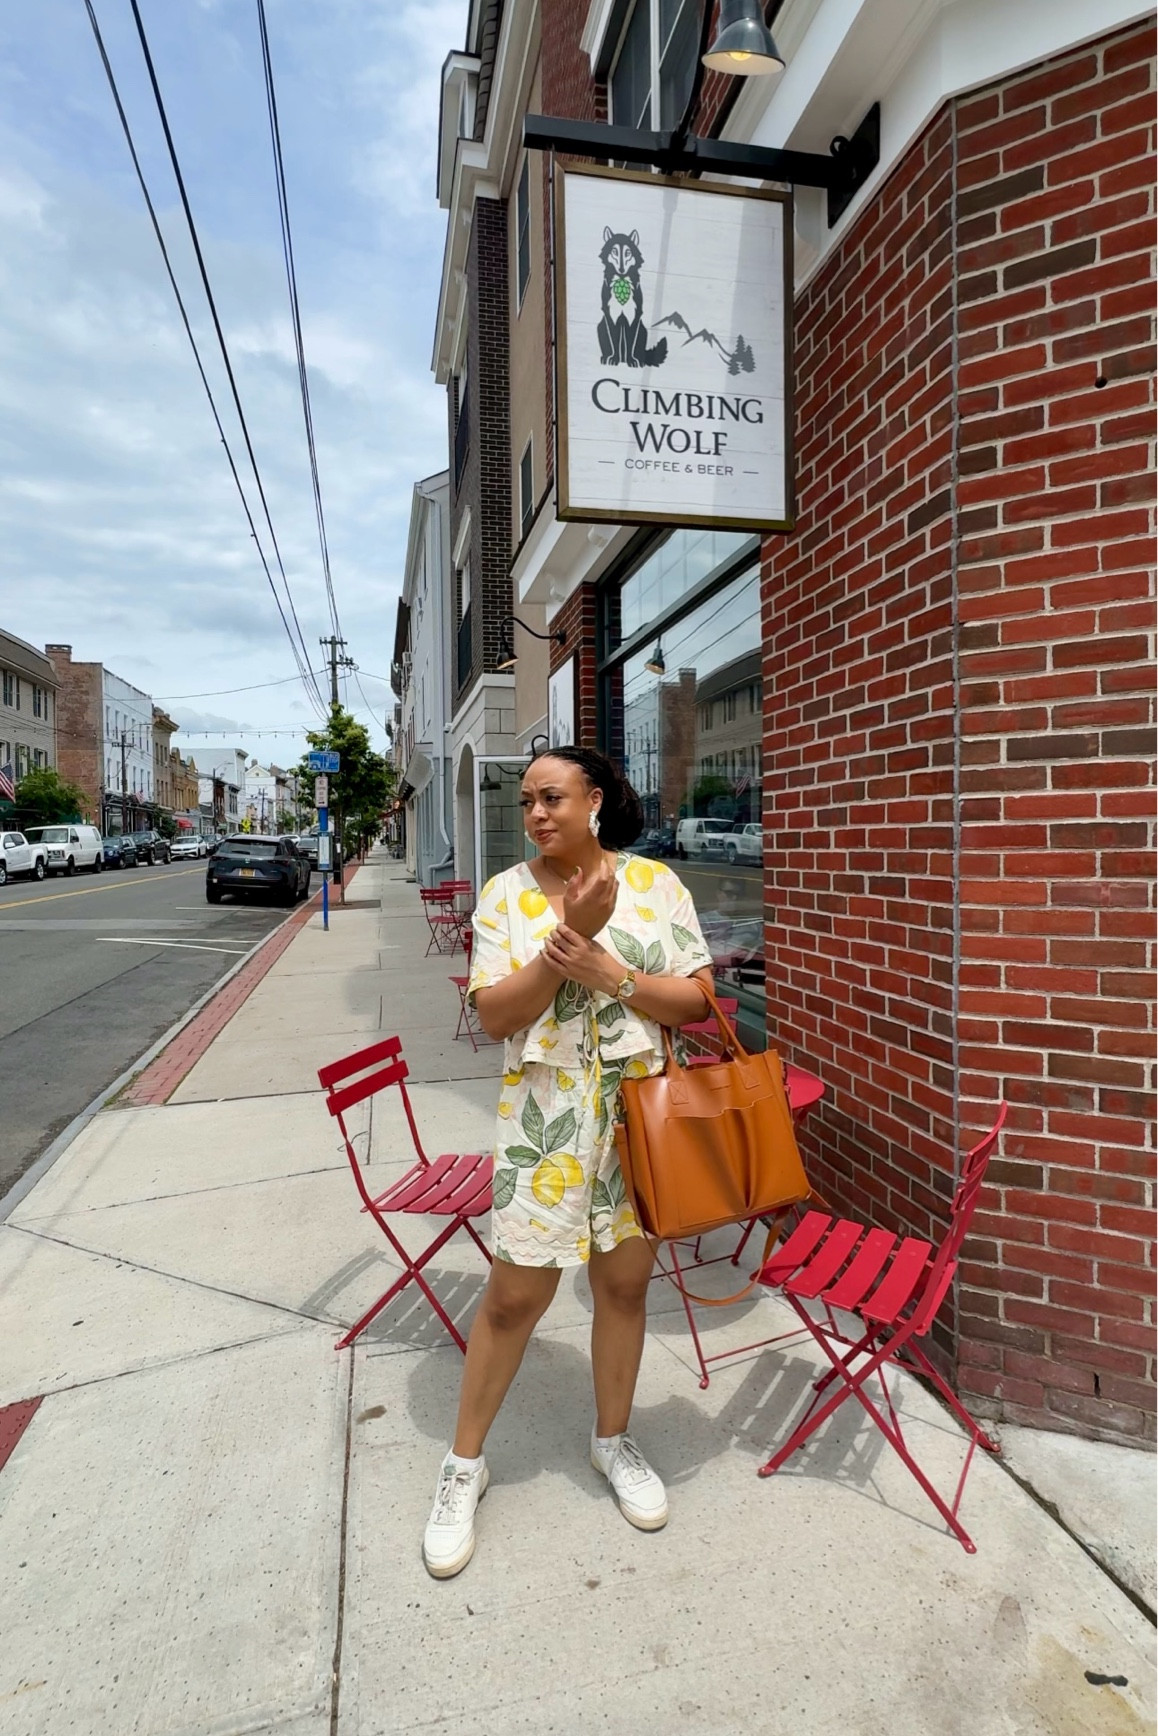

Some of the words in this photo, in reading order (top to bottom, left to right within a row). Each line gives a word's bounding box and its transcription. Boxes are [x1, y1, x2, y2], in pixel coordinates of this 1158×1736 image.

[591, 378, 763, 424] CLIMBING
[630, 421, 728, 456] WOLF
[624, 458, 680, 473] COFFEE
[684, 464, 693, 473] &
[697, 464, 734, 476] BEER
